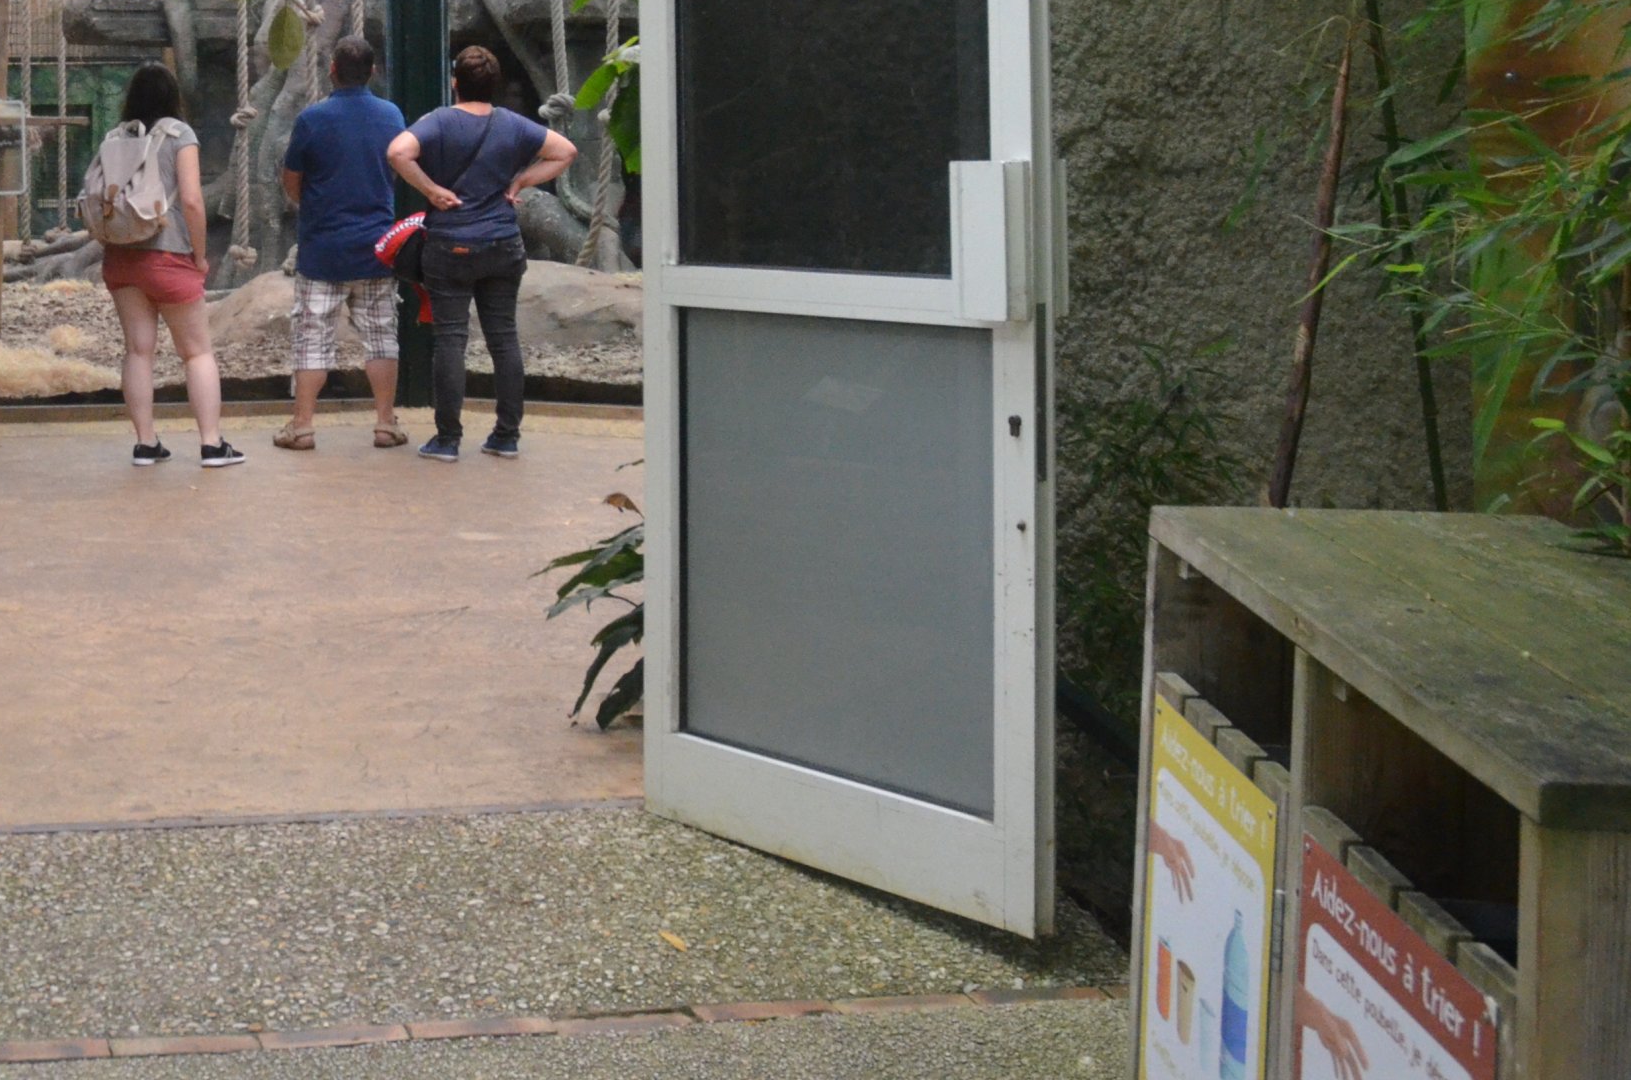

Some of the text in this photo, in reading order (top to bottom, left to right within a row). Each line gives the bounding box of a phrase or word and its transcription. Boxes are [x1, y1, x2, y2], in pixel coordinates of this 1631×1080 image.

[1311, 870, 1398, 976] Aidez-nous
[1402, 952, 1415, 995] à
[1422, 965, 1465, 1039] trier
[1473, 1019, 1481, 1058] !
